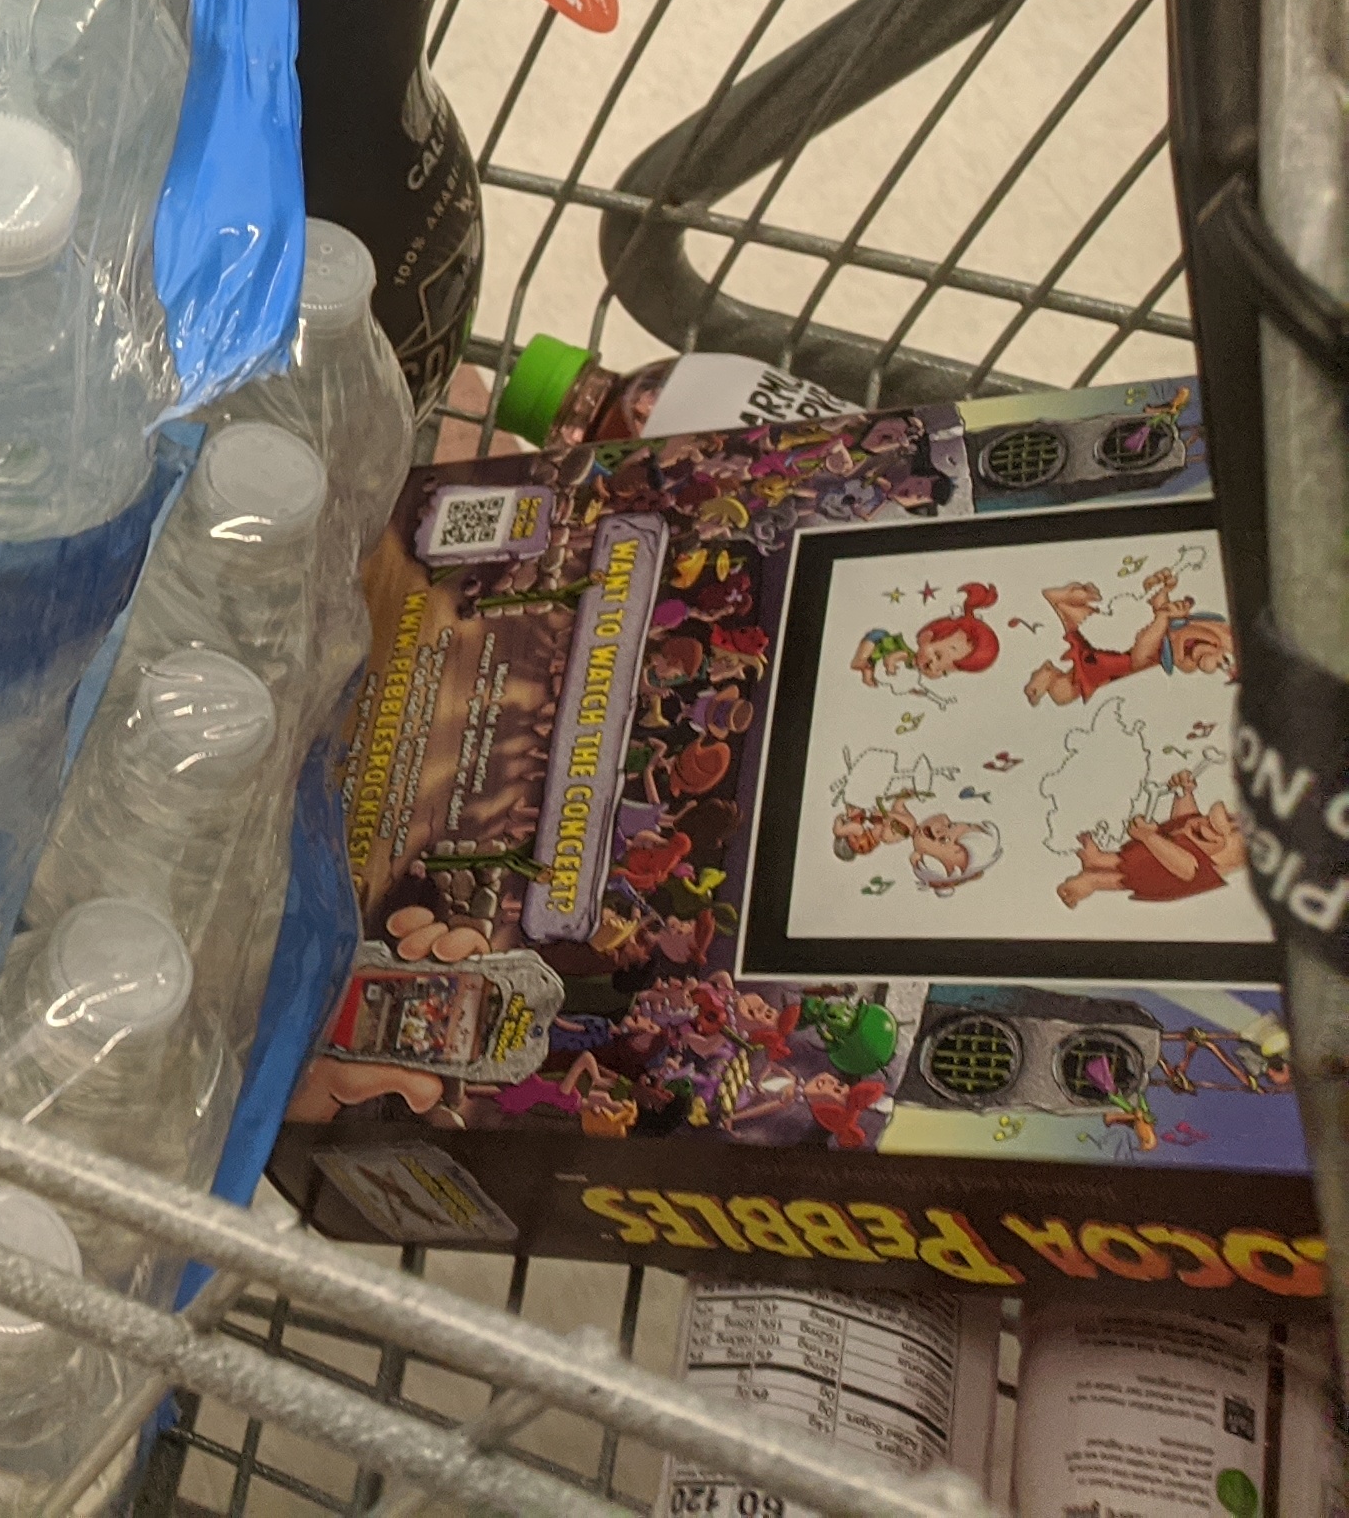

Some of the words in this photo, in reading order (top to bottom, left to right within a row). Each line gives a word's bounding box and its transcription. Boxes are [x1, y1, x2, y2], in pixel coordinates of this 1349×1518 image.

[390, 233, 429, 287] 100%
[601, 537, 637, 604] WANT
[596, 607, 623, 639] TO
[577, 642, 617, 727] WATCH
[567, 729, 600, 778] THE
[544, 785, 592, 914] CONCERT?
[582, 1187, 1022, 1285] PEBBLES
[1004, 1213, 1327, 1296] OCOA
